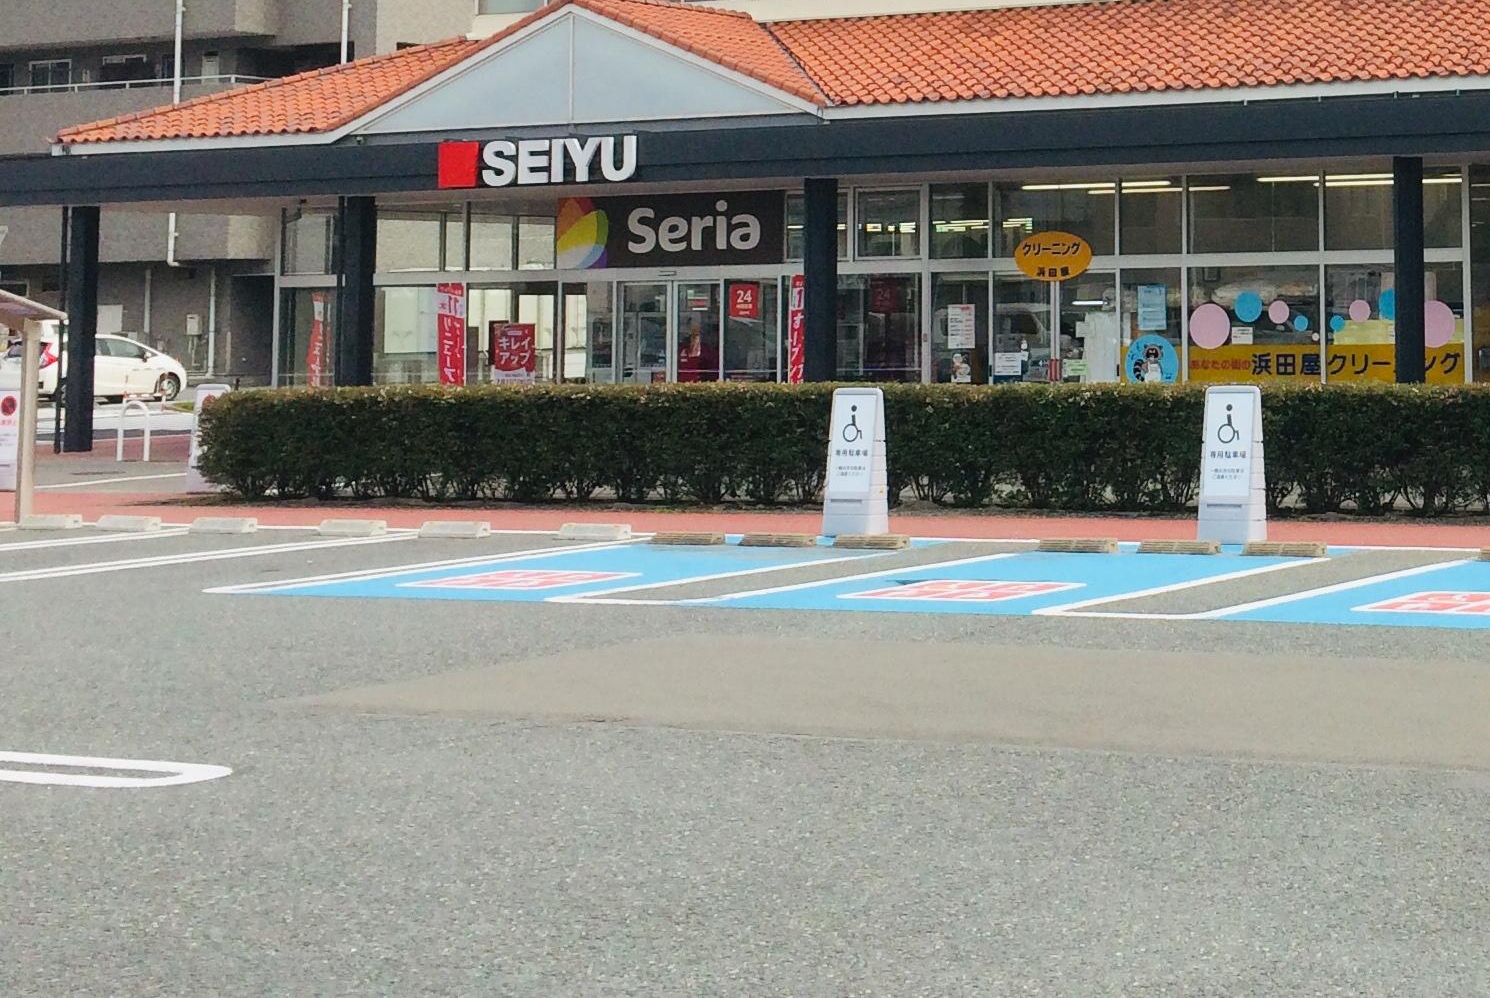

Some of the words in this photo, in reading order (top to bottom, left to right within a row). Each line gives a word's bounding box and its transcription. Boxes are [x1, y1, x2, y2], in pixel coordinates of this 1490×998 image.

[481, 135, 638, 187] SEIYU
[627, 199, 761, 254] Seria
[1022, 242, 1081, 256] クリーニング
[736, 289, 753, 304] 24
[499, 336, 532, 350] キレイ
